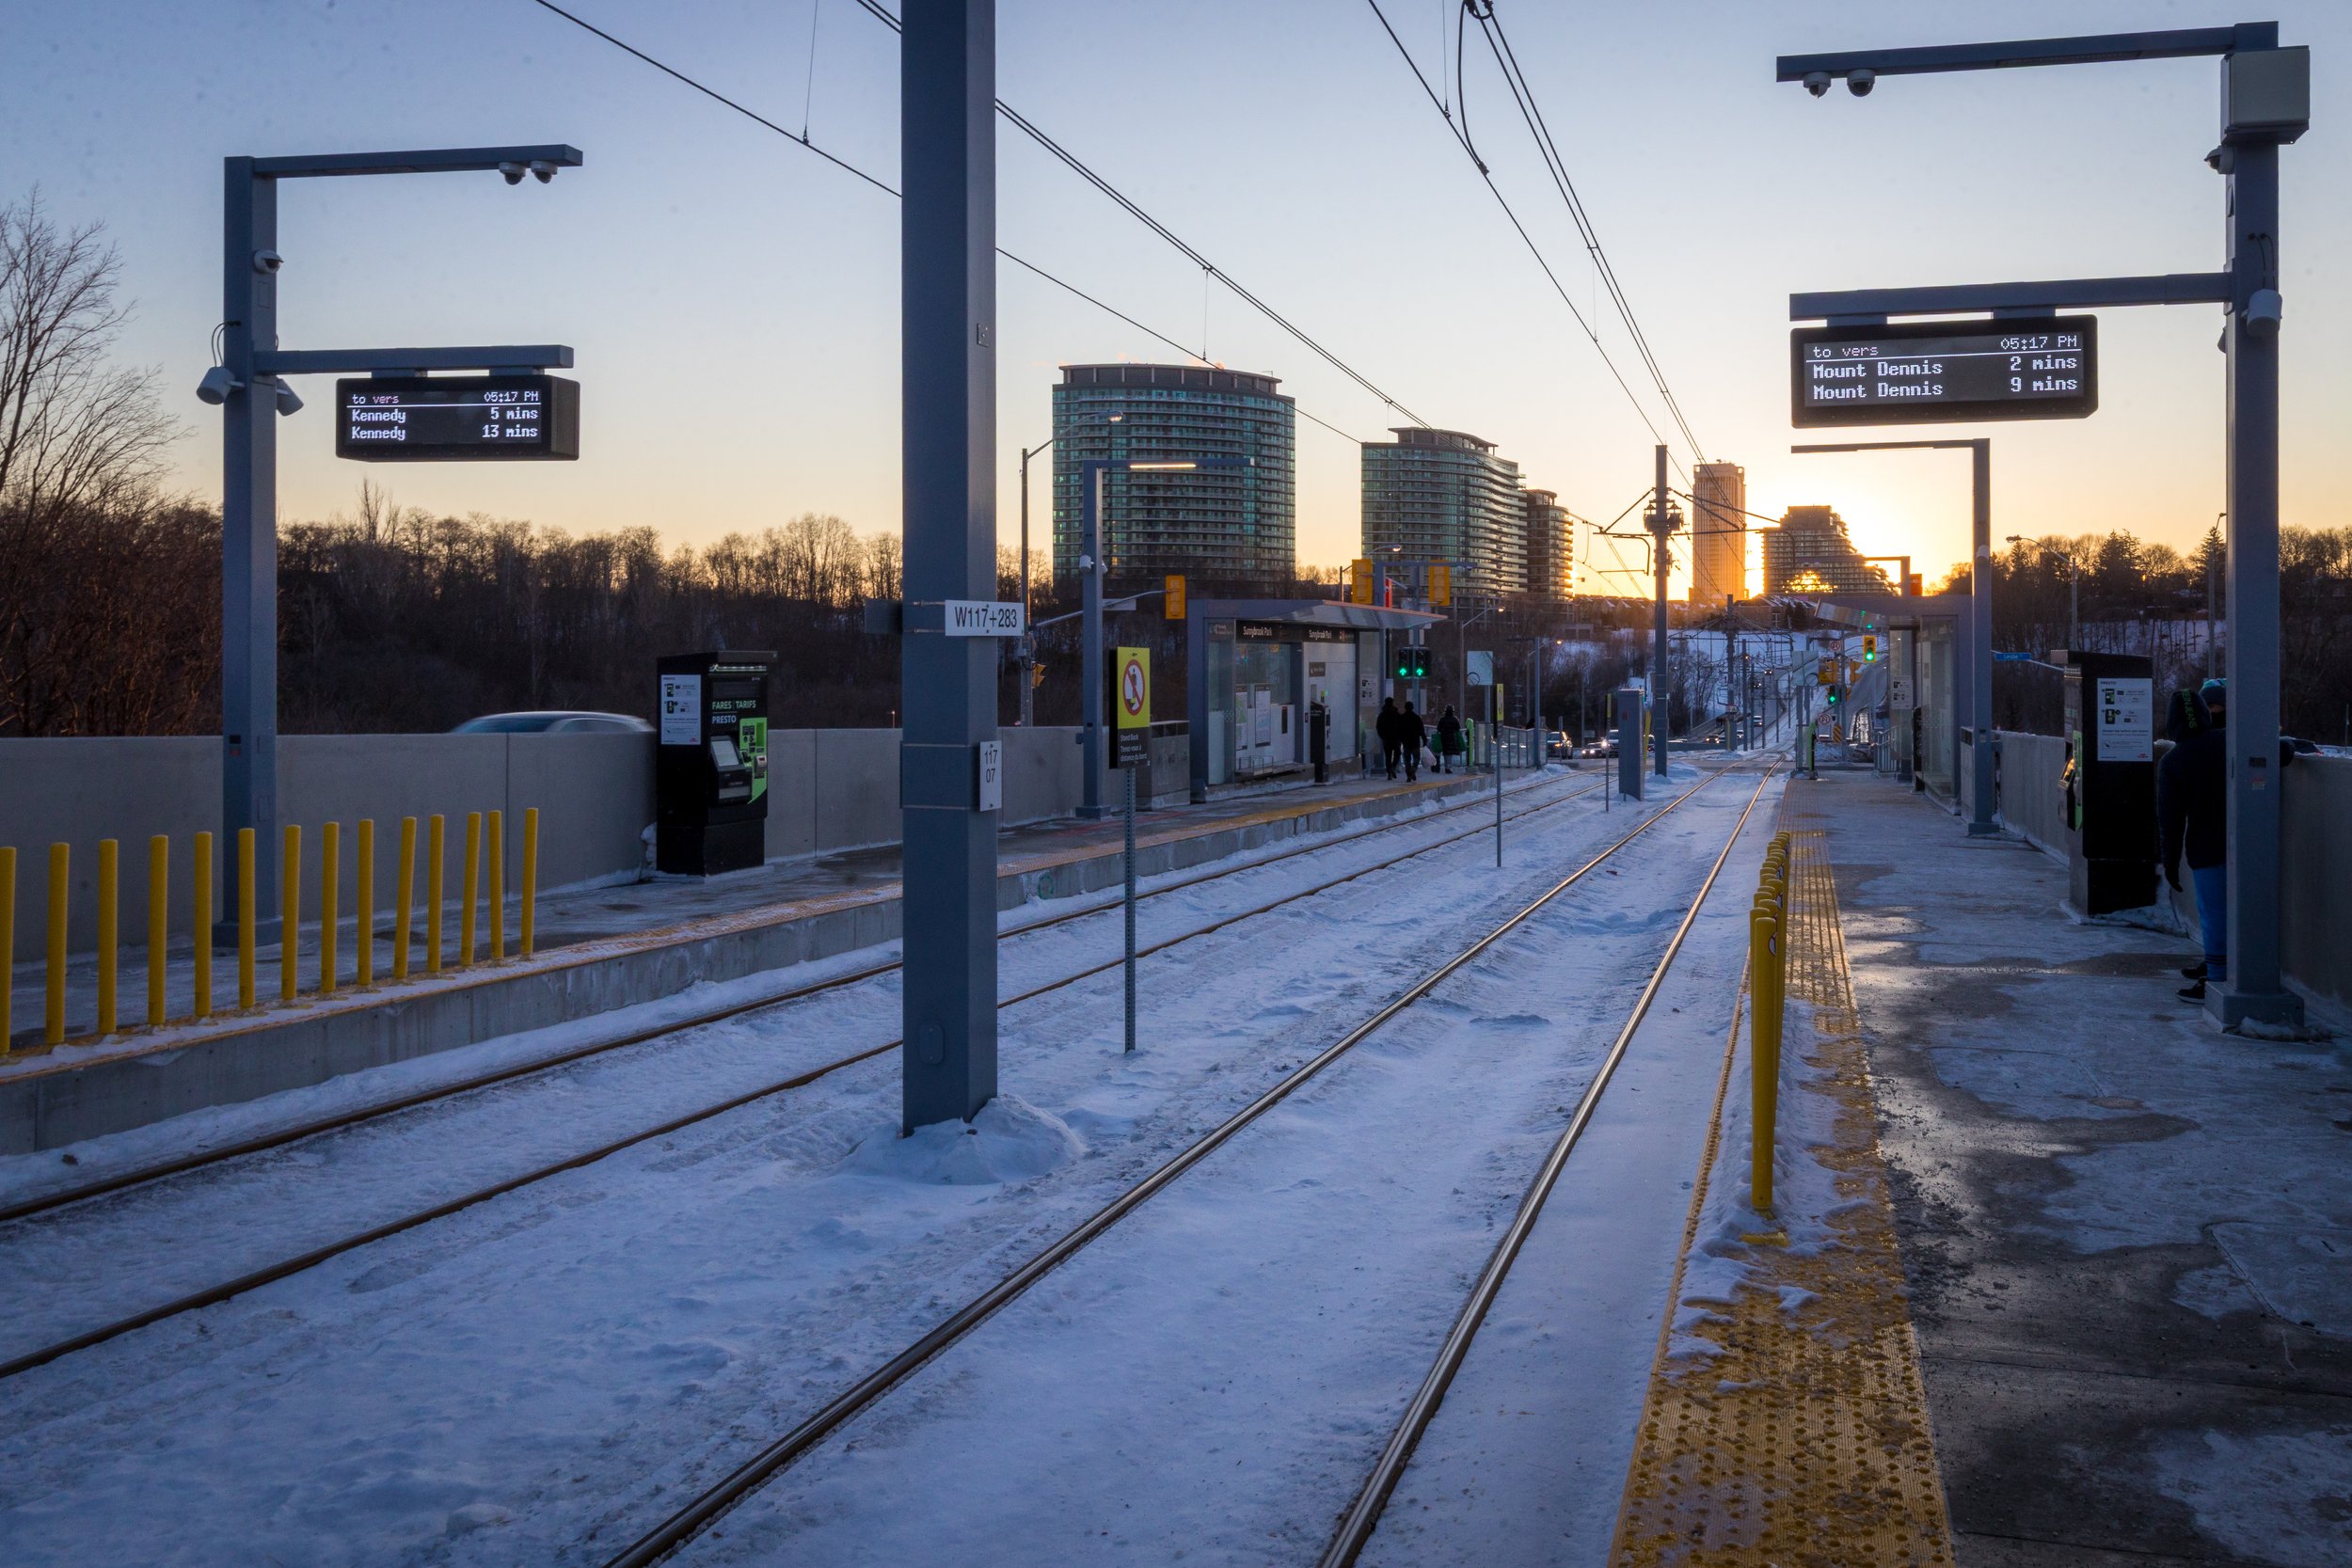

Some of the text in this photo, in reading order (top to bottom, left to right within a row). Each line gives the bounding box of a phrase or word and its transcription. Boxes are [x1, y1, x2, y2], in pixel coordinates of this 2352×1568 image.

[2000, 335, 2077, 350] 05:17 PM
[1813, 346, 1879, 357] to vers
[1813, 359, 1943, 379] Mount Dennis
[2010, 355, 2077, 372] 2 mins
[1813, 380, 1943, 400] Mount Dennis
[2010, 375, 2078, 392] 9 mins
[352, 393, 400, 404] to vers
[484, 390, 539, 403] 05:17 PM
[352, 408, 406, 424] Kennedy
[490, 406, 538, 420] 5 mins
[352, 425, 405, 441] Kennedy
[482, 423, 538, 438] 13 mins
[954, 606, 1018, 628] W117+283
[1264, 626, 1273, 637] Park
[711, 700, 757, 710] FARES TARIFS
[711, 715, 738, 724] PRESTO
[984, 749, 998, 765] 117
[985, 768, 996, 784] 07
